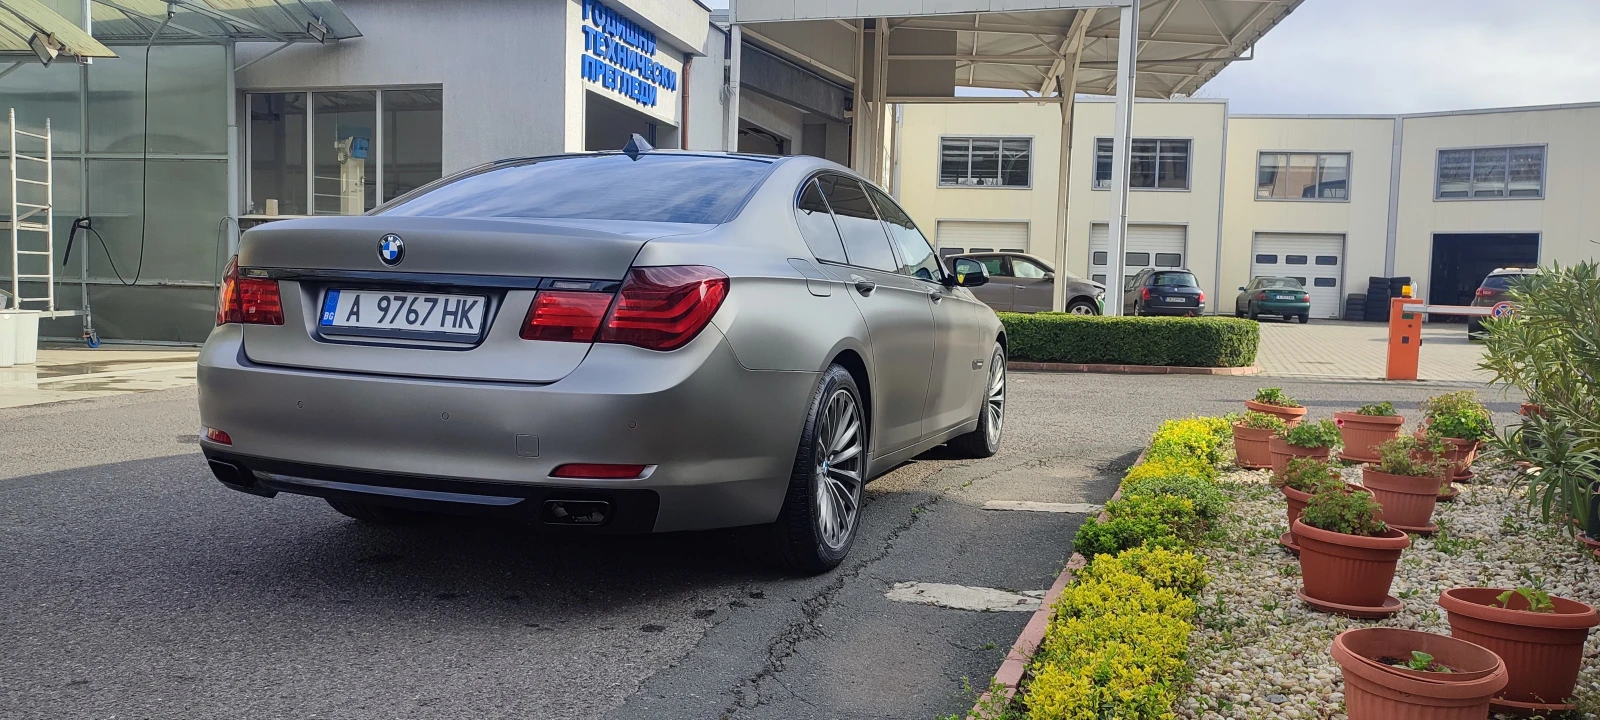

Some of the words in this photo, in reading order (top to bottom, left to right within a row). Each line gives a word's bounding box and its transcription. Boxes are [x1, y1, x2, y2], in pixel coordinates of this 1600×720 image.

[581, 0, 657, 57] ГОДИШНИ
[581, 53, 657, 108] ПРЕГЛЕДИ
[582, 24, 677, 93] ТЕХНИЧЕСКИ
[323, 312, 335, 321] BG
[346, 295, 361, 323] A
[377, 296, 439, 326] 9767
[440, 298, 479, 330] HK
